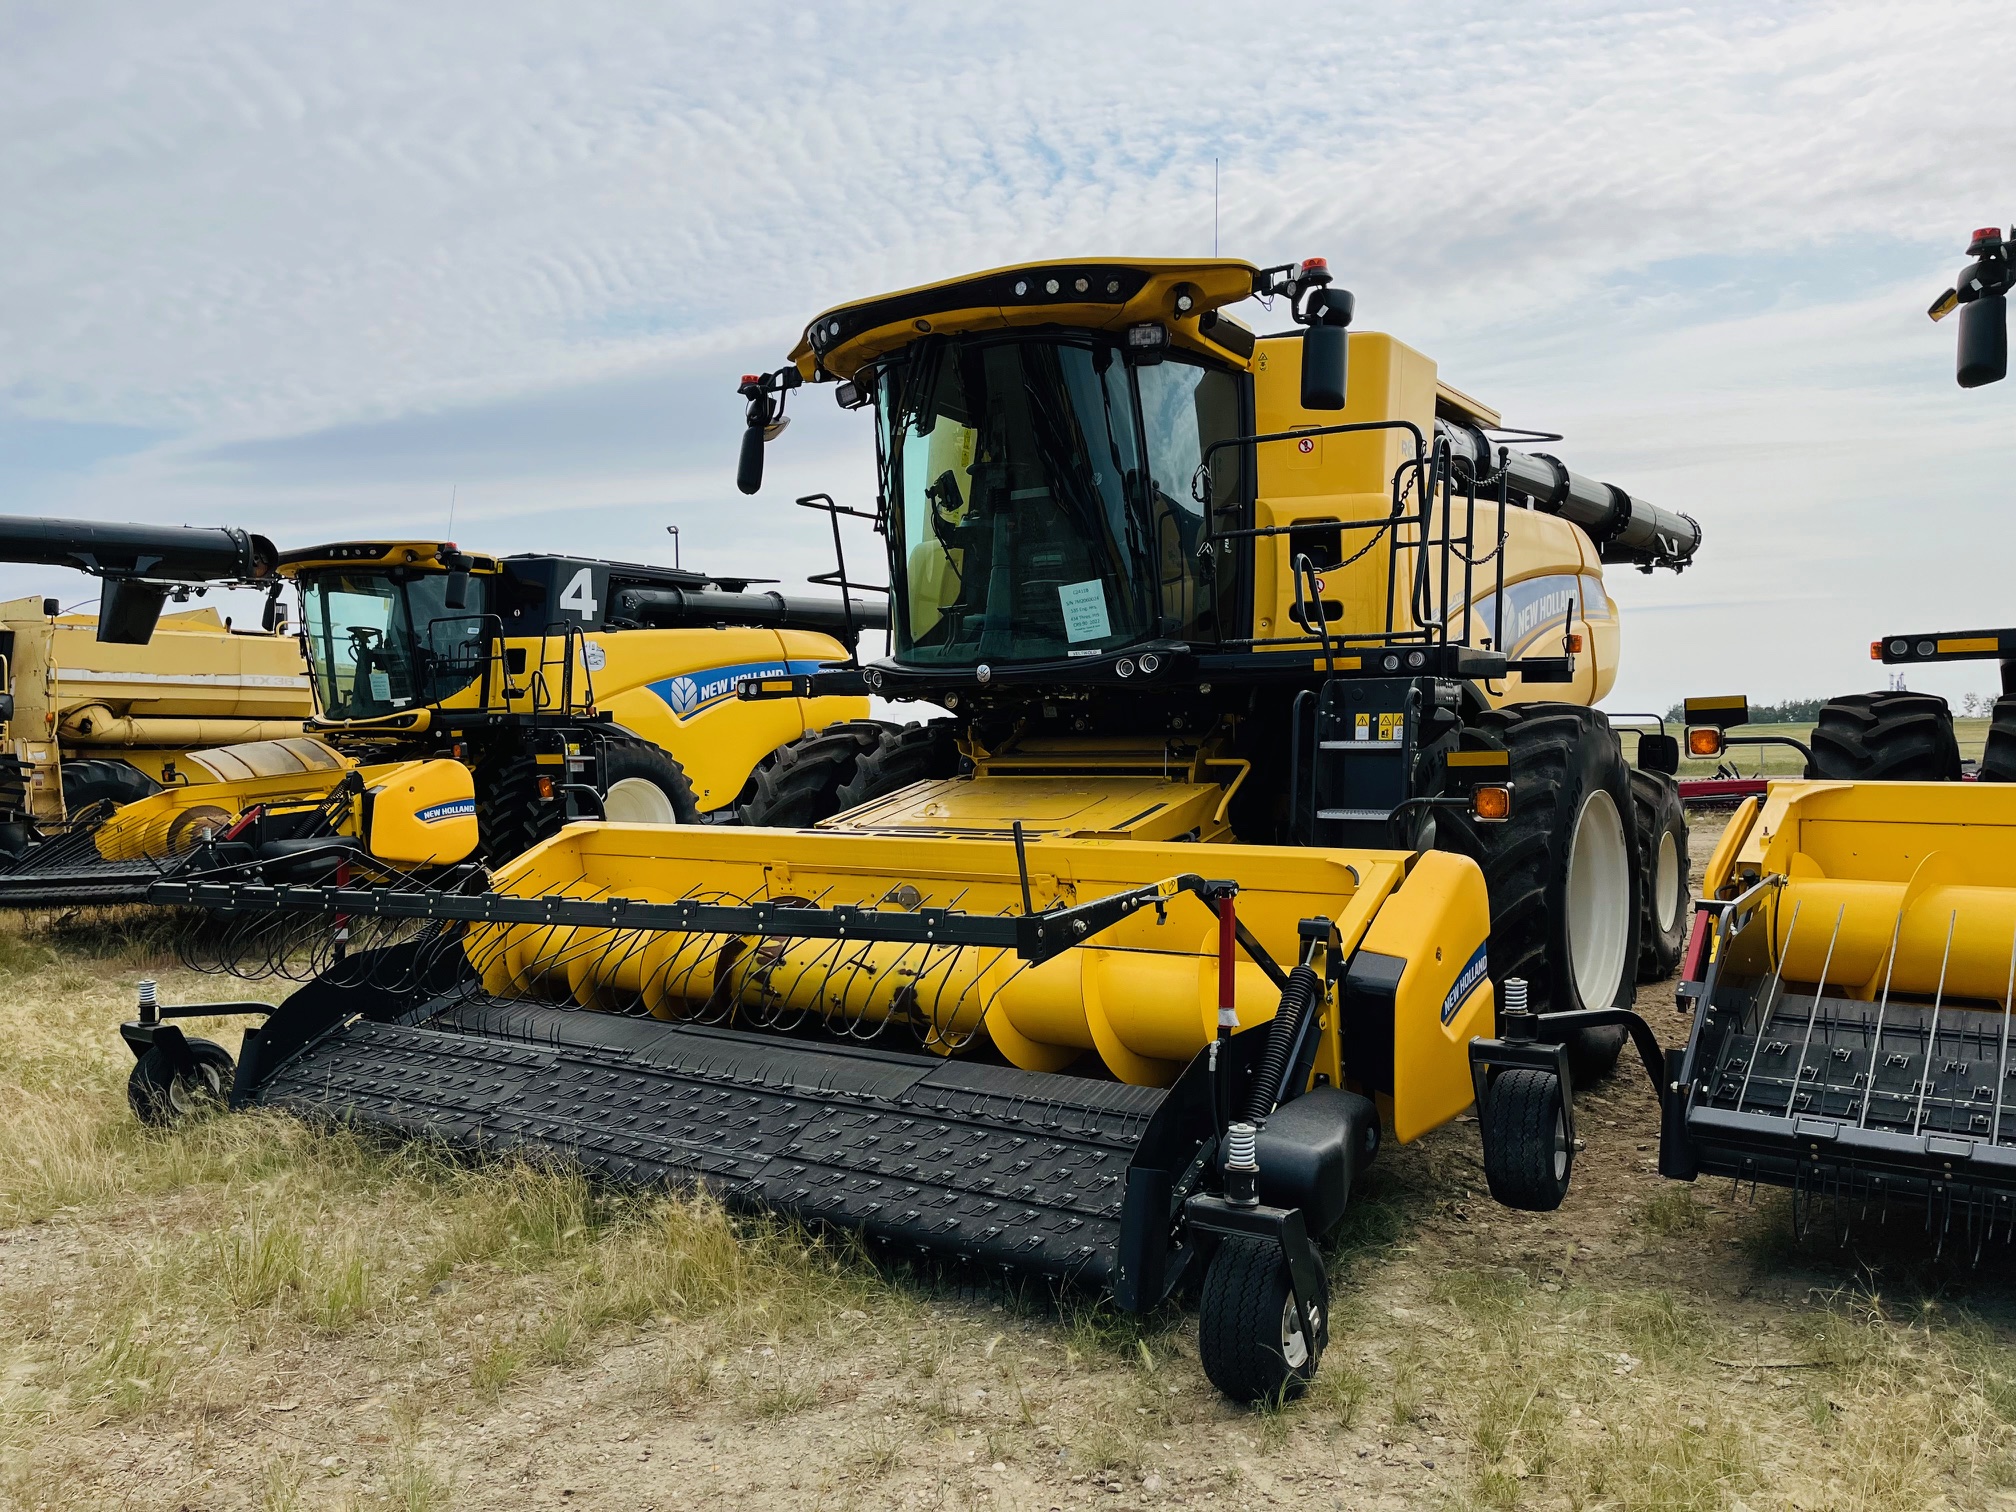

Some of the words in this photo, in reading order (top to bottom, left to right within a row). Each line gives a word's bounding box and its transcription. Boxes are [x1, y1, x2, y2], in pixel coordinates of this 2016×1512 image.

[560, 568, 597, 621] 4
[1518, 600, 1538, 638] NEW
[1540, 589, 1578, 622] HOLLAND
[249, 676, 271, 686] TX
[701, 678, 728, 701] NEW
[424, 809, 441, 820] NEW
[441, 805, 475, 815] HOLLAND
[1444, 982, 1460, 1015] NEW
[1460, 955, 1487, 995] HOLLAND
